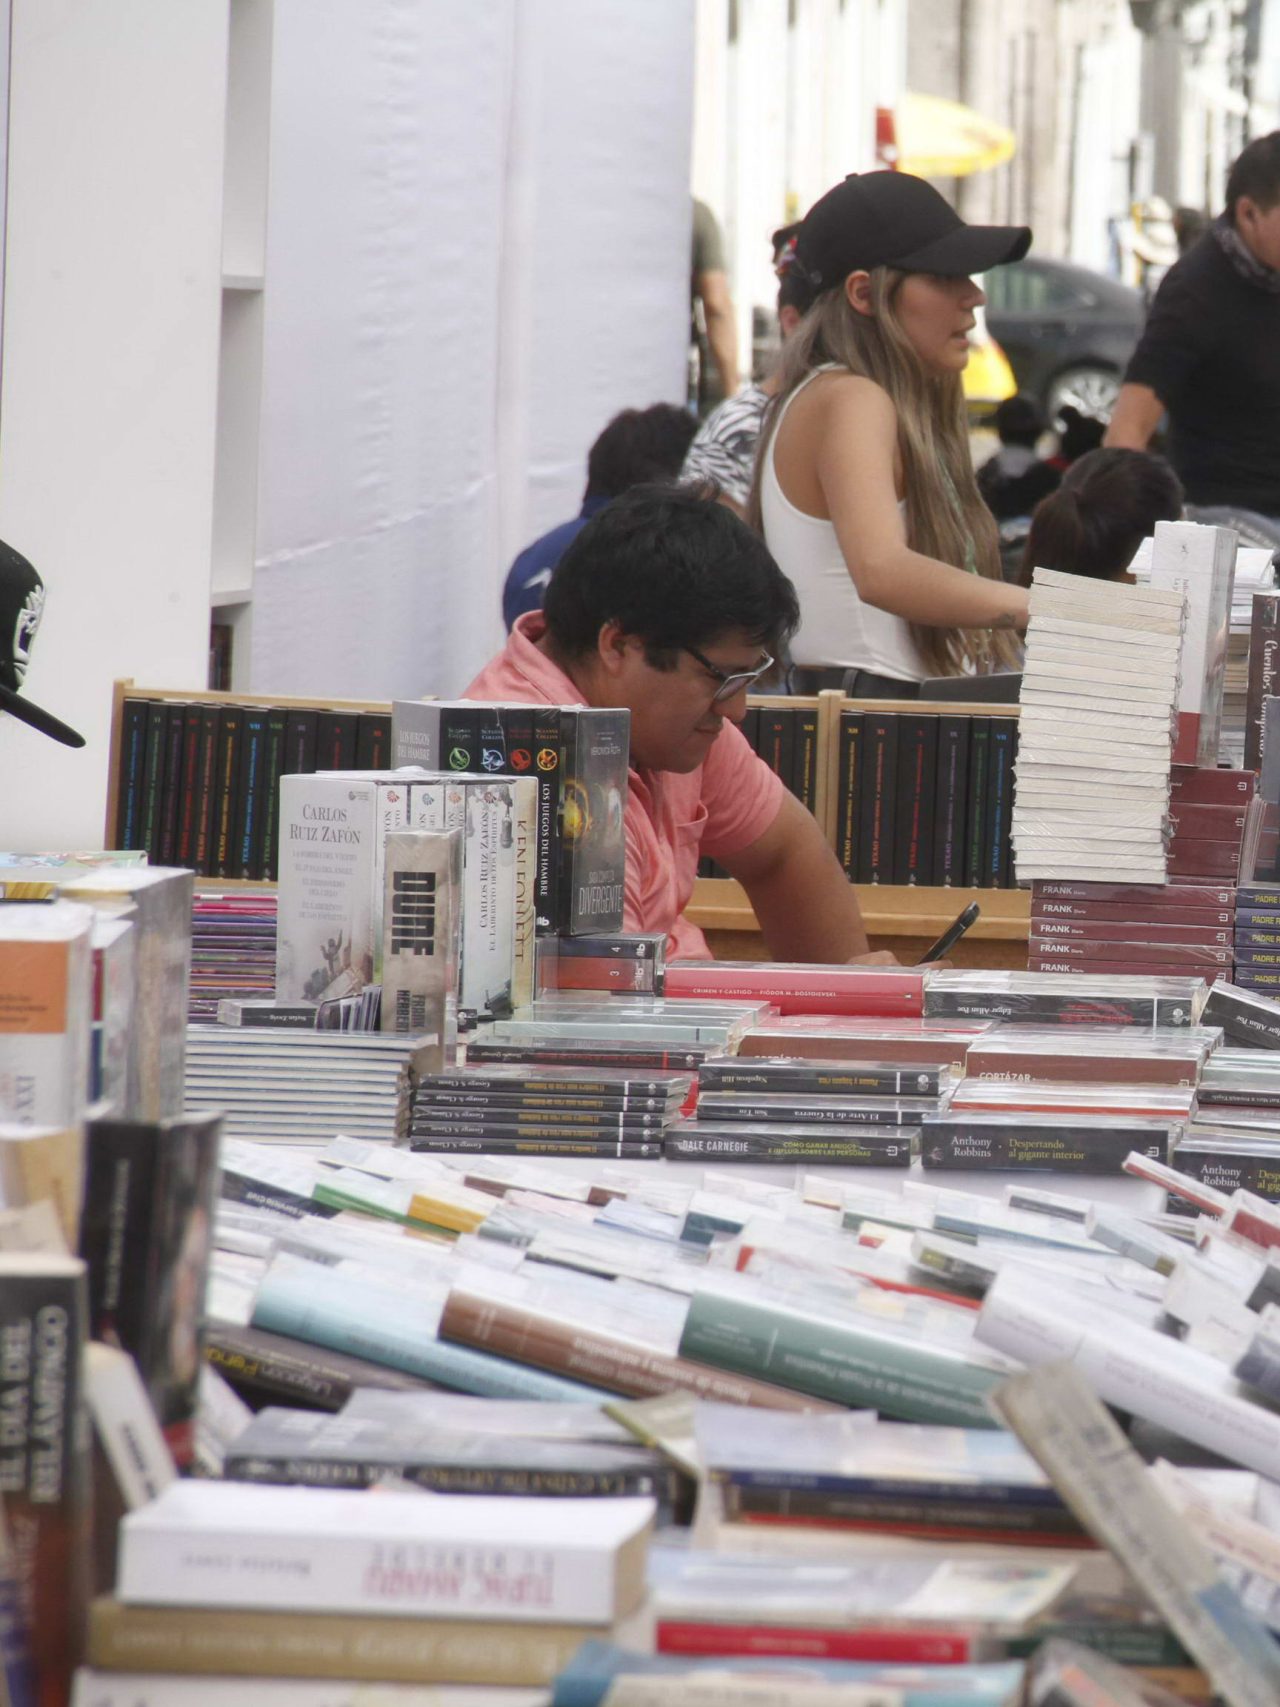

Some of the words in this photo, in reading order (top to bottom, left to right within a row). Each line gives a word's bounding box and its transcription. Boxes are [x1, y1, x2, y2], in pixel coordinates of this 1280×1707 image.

[1263, 640, 1278, 690] Cuentos
[542, 783, 550, 801] LOS
[303, 804, 347, 822] CARLOS
[541, 801, 550, 834] JUEGOS
[289, 824, 318, 841] RUIZ
[321, 826, 361, 844] ZAFÓN
[540, 835, 549, 856] DEL
[540, 856, 549, 896] HAMBRE
[1043, 886, 1072, 895] FRANK
[579, 885, 623, 915] DIVERGENTE
[1255, 895, 1277, 903] PADRE
[1043, 904, 1072, 913] FRANK
[1252, 916, 1273, 924] PADRE
[1041, 924, 1070, 933] FRANK
[1040, 944, 1069, 953] FRANK
[1041, 963, 1070, 972] FRANK
[957, 1006, 970, 1014] Poe
[972, 1007, 990, 1015] Allan
[991, 1006, 1012, 1016] Edgar
[1236, 1015, 1248, 1025] Poe
[1250, 1019, 1267, 1032] Allan
[795, 1110, 824, 1119] Guerra
[827, 1111, 834, 1119] la
[849, 1112, 867, 1120] Arte
[682, 1140, 703, 1151] DALE
[706, 1141, 748, 1152] CARNEGIE
[951, 1136, 992, 1148] Anthony
[1009, 1138, 1065, 1149] Despertando
[954, 1147, 991, 1158] Robbins
[1008, 1150, 1016, 1158] al
[1018, 1151, 1050, 1160] gigante
[1052, 1152, 1085, 1160] interior
[1200, 1164, 1241, 1178] Anthony
[1203, 1175, 1241, 1188] Robbins
